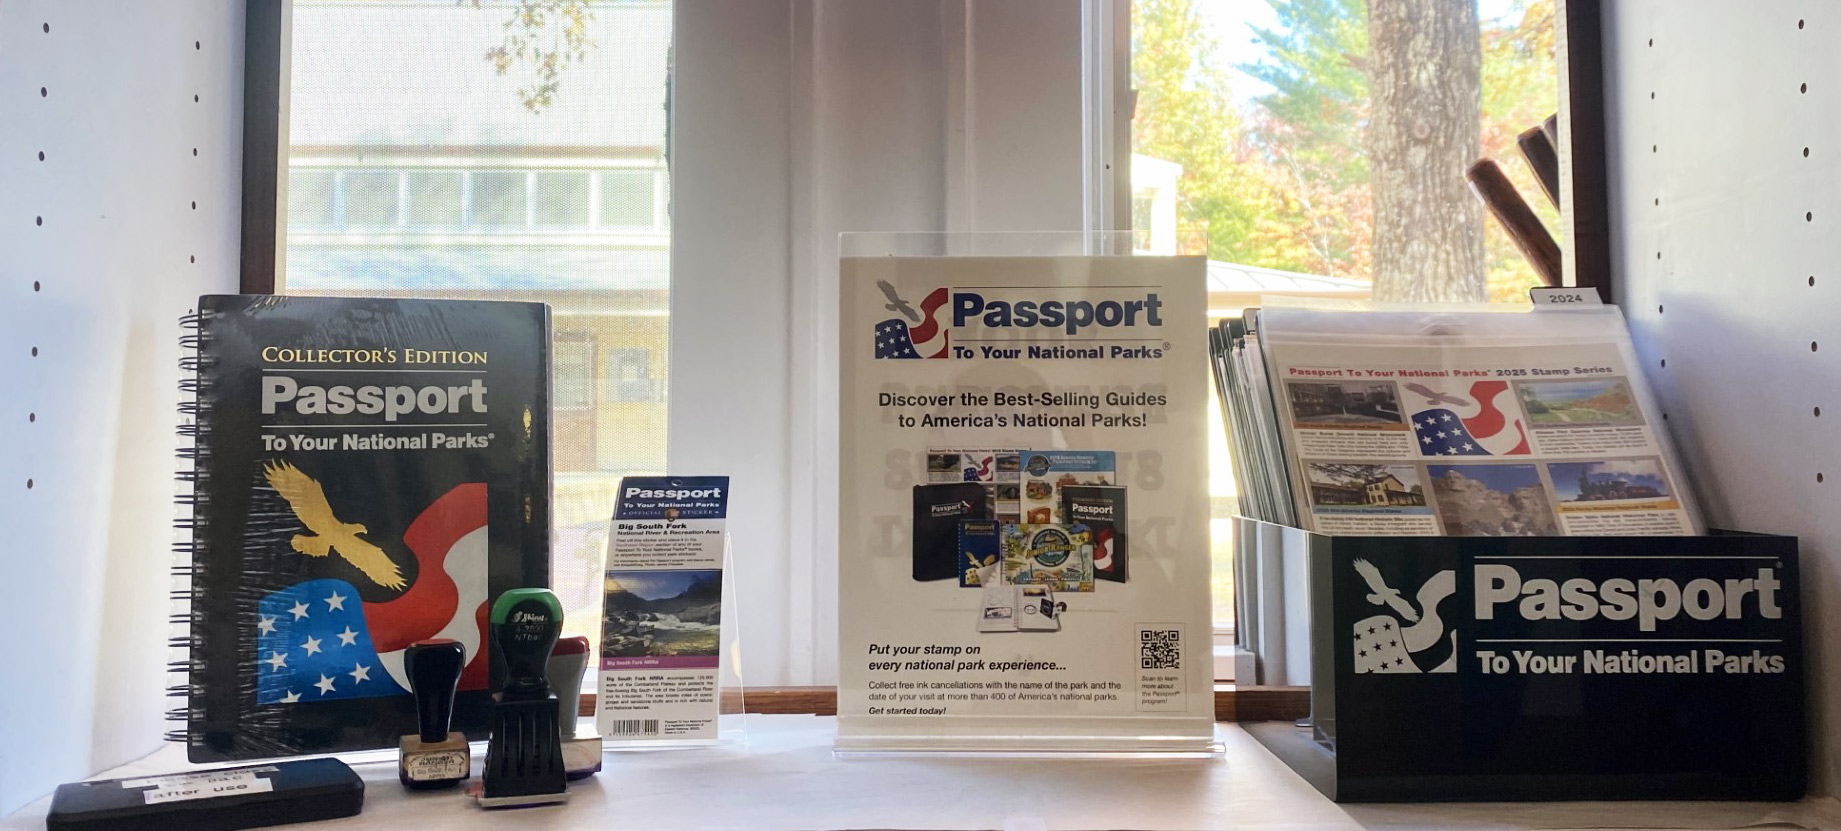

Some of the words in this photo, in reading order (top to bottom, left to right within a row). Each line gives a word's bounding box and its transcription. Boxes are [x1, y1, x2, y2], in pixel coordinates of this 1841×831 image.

[1549, 295, 1582, 303] 2024
[953, 293, 1162, 335] Passport
[953, 347, 972, 359] To
[981, 347, 1021, 359] Your
[1028, 346, 1103, 358] National
[1290, 368, 1343, 378] Passport
[1532, 368, 1569, 376] Stamp
[1574, 366, 1612, 374] Series
[262, 377, 487, 421] Passport
[879, 393, 955, 408] Discover
[961, 393, 988, 407] the
[995, 392, 1099, 409] Best-Selling
[1106, 392, 1167, 407] Guides
[899, 414, 915, 428] to
[921, 414, 1007, 428] America's
[1013, 413, 1086, 427] National
[1092, 413, 1147, 427] Parks!
[262, 435, 285, 451] To
[289, 435, 337, 450] Your
[343, 434, 426, 450] National
[626, 488, 721, 500] Passport
[1072, 503, 1113, 514] Passport
[1475, 564, 1782, 632] Passport
[869, 644, 891, 655] Put
[893, 646, 921, 657] your
[924, 645, 962, 657] stamp
[966, 646, 980, 655] on
[869, 662, 900, 672] every
[905, 660, 954, 670] national
[957, 660, 985, 672] park
[1476, 651, 1510, 673] To
[1513, 650, 1576, 673] Your
[1584, 650, 1697, 673] National
[1705, 650, 1785, 673] Parks
[869, 681, 896, 689] Collect
[899, 681, 914, 689] free
[931, 681, 983, 689] cancellations
[1045, 681, 1053, 689] of
[1070, 681, 1088, 691] park
[1094, 693, 1118, 702] parks.
[886, 707, 917, 715] started
[919, 707, 946, 715] today!
[153, 788, 200, 798] after
[213, 784, 248, 792] use
